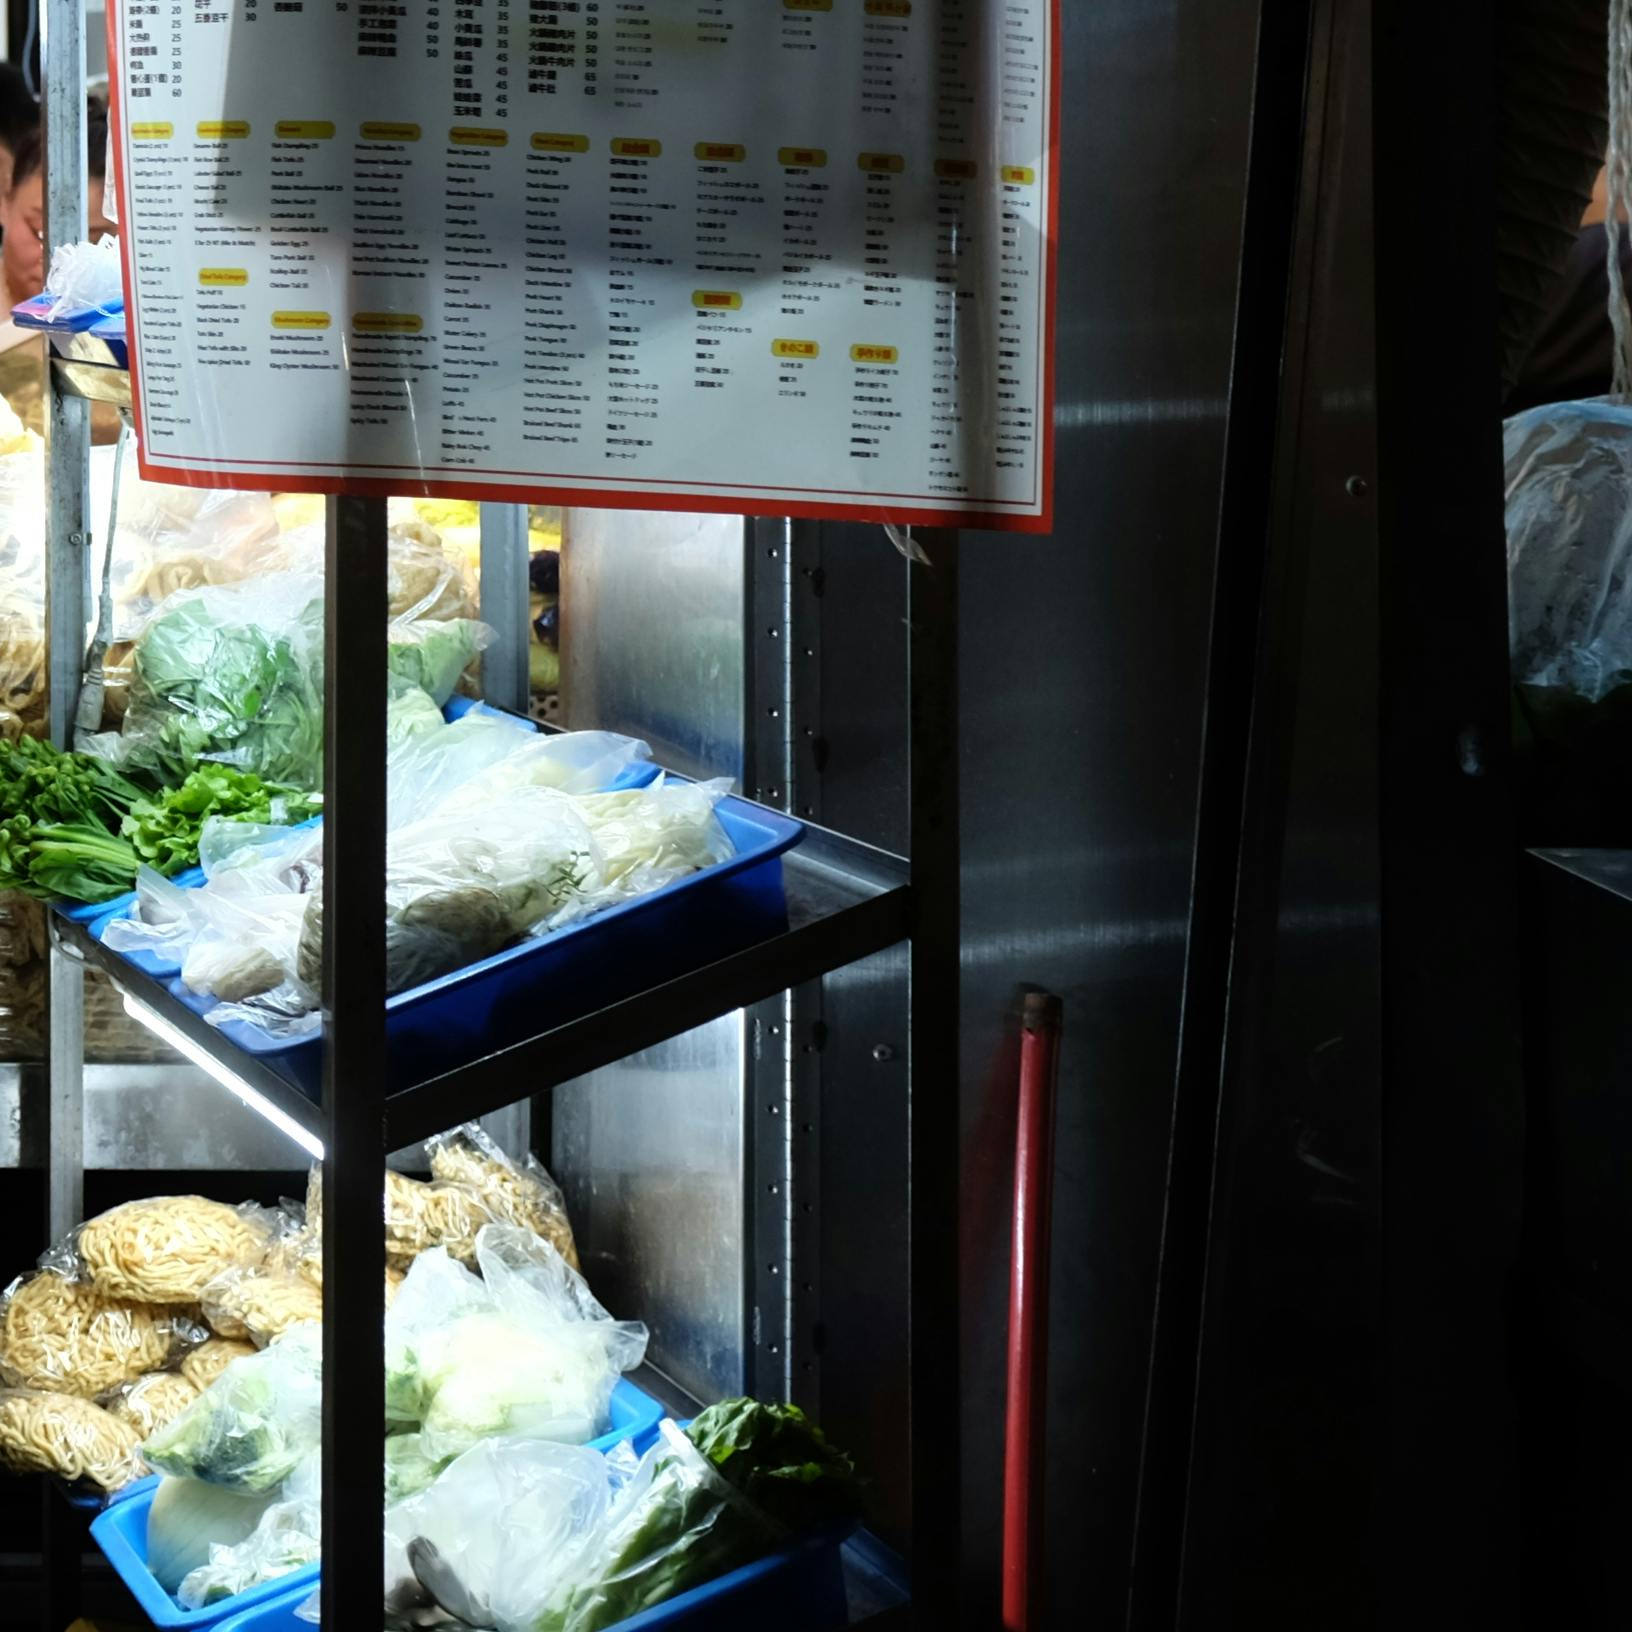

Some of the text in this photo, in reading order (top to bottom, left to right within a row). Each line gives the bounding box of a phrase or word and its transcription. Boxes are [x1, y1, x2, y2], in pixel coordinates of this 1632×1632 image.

[246, 0, 258, 8] 20
[586, 3, 598, 12] 60
[427, 8, 439, 16] 40
[498, 12, 509, 20] 35
[246, 13, 257, 21] 30
[587, 17, 598, 26] 50
[427, 22, 439, 30] 40
[498, 25, 508, 34] 35
[172, 33, 181, 42] 25
[427, 35, 438, 44] 50
[427, 49, 438, 57] 50
[586, 59, 597, 67] 50
[496, 81, 507, 89] 45
[584, 86, 596, 95] 65
